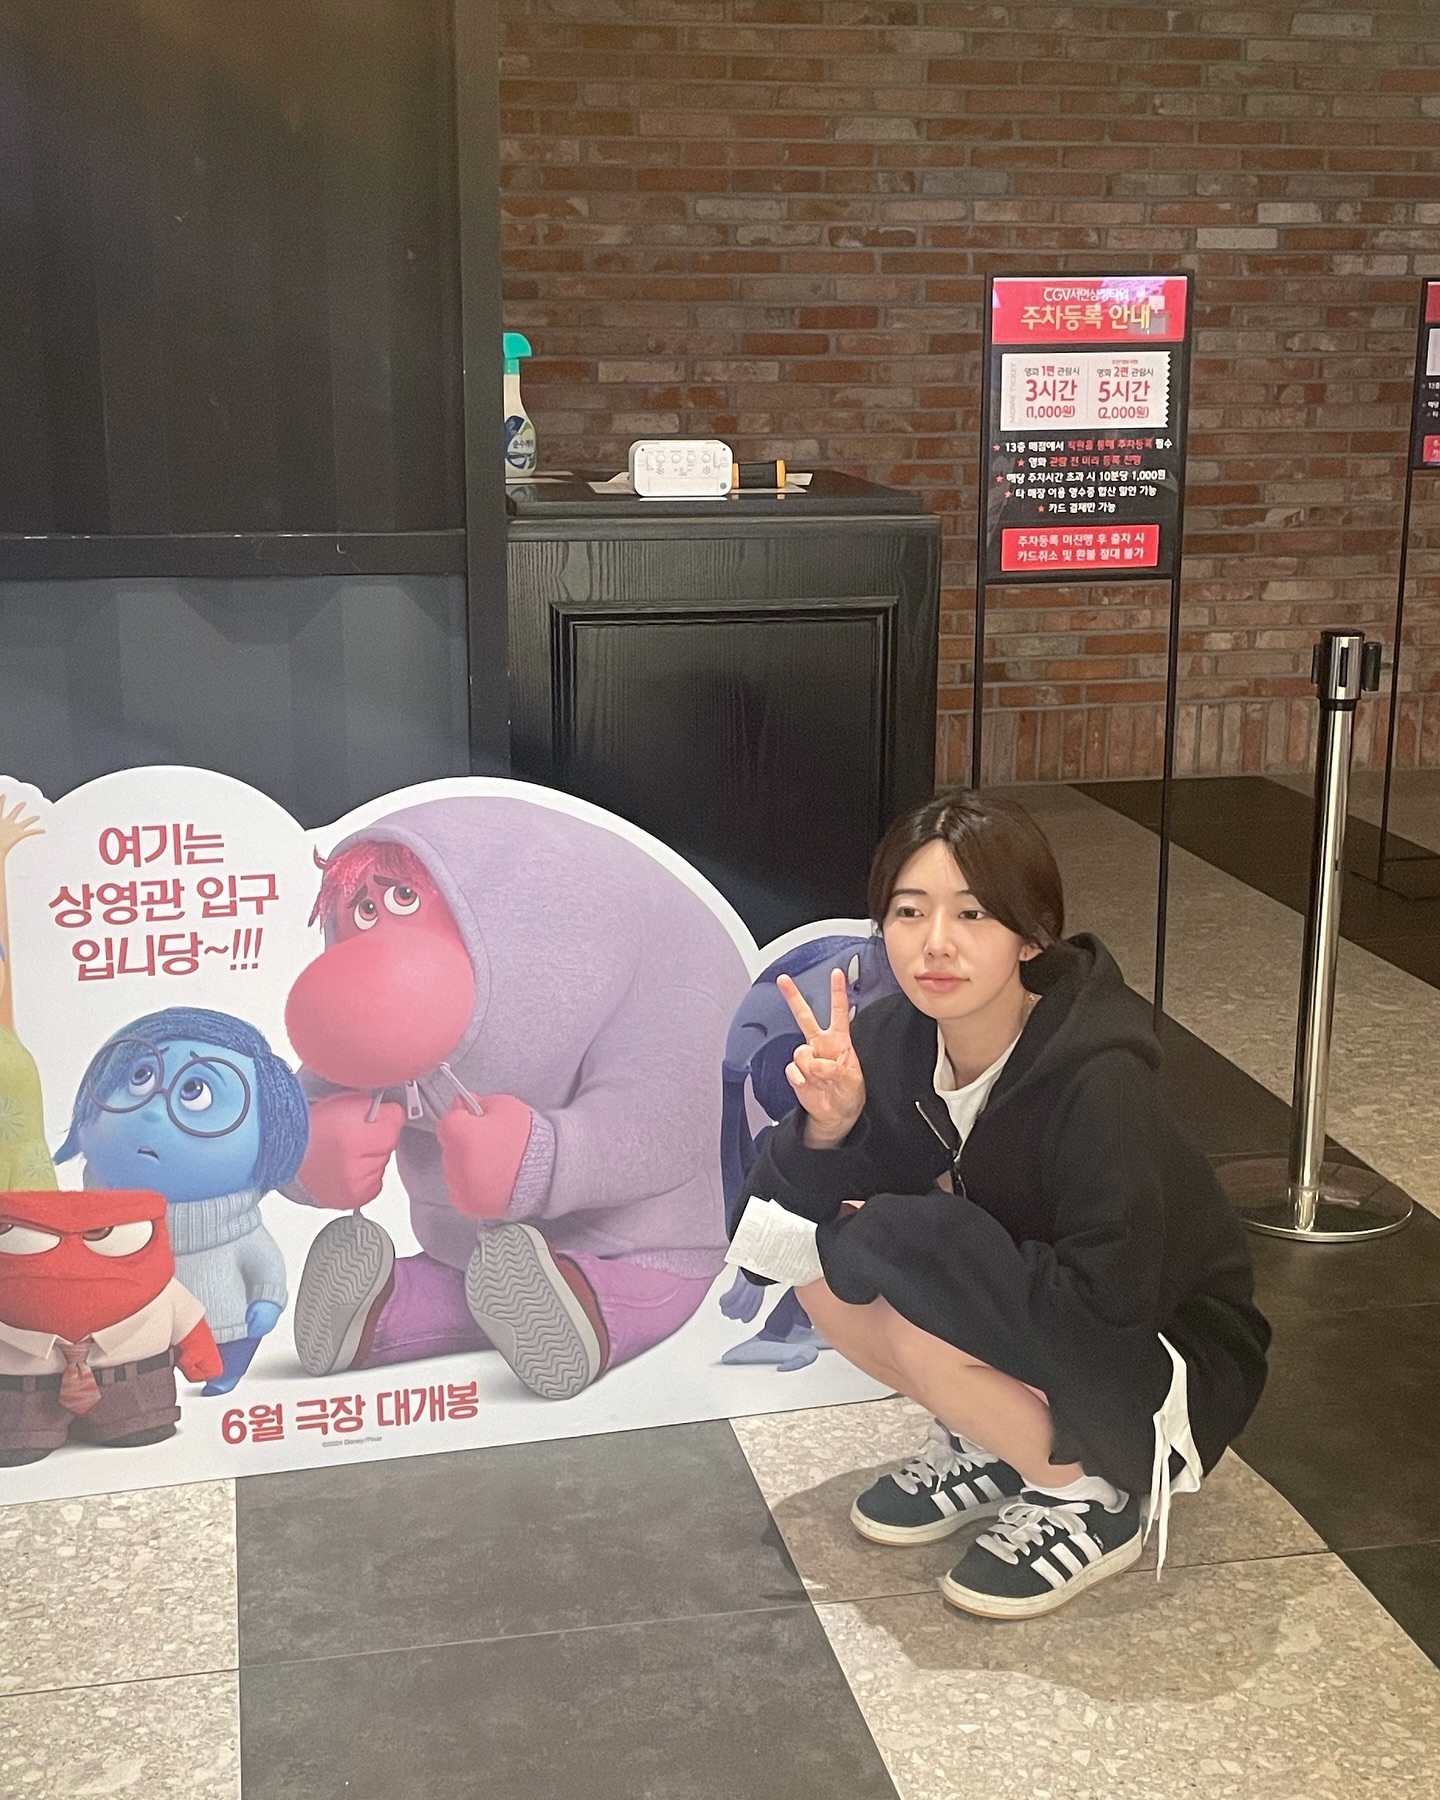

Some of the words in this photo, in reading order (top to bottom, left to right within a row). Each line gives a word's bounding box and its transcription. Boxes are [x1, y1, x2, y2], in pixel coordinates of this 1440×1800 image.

[1021, 305, 1104, 330] 주차등록
[1108, 304, 1151, 330] 안내
[1041, 366, 1054, 376] 1편
[1114, 366, 1129, 377] 2편
[1026, 380, 1078, 402] 3시간
[1098, 380, 1150, 402] 5시간
[1026, 406, 1075, 420] (1,000원)
[1098, 406, 1148, 420] (2,000원)
[1086, 471, 1096, 482] 시
[1132, 470, 1166, 482] 1,000원
[1015, 488, 1024, 500] 타
[1048, 487, 1066, 499] 이용
[1068, 486, 1095, 499] 영수증
[1048, 503, 1066, 514] 카드
[1098, 502, 1116, 514] 가능
[1018, 534, 1059, 546] 주차등록
[1062, 533, 1094, 546] 미진행
[1096, 534, 1107, 544] 후
[1134, 532, 1144, 544] 시
[1017, 550, 1058, 562] 카드취소
[99, 824, 224, 868] 여기는
[48, 878, 186, 928] 상영관
[196, 874, 279, 918] 입구
[72, 928, 264, 981] 입니당~!!!
[221, 1403, 285, 1444] 6월
[296, 1394, 366, 1436] 극장
[376, 1381, 480, 1426] 대개봉
